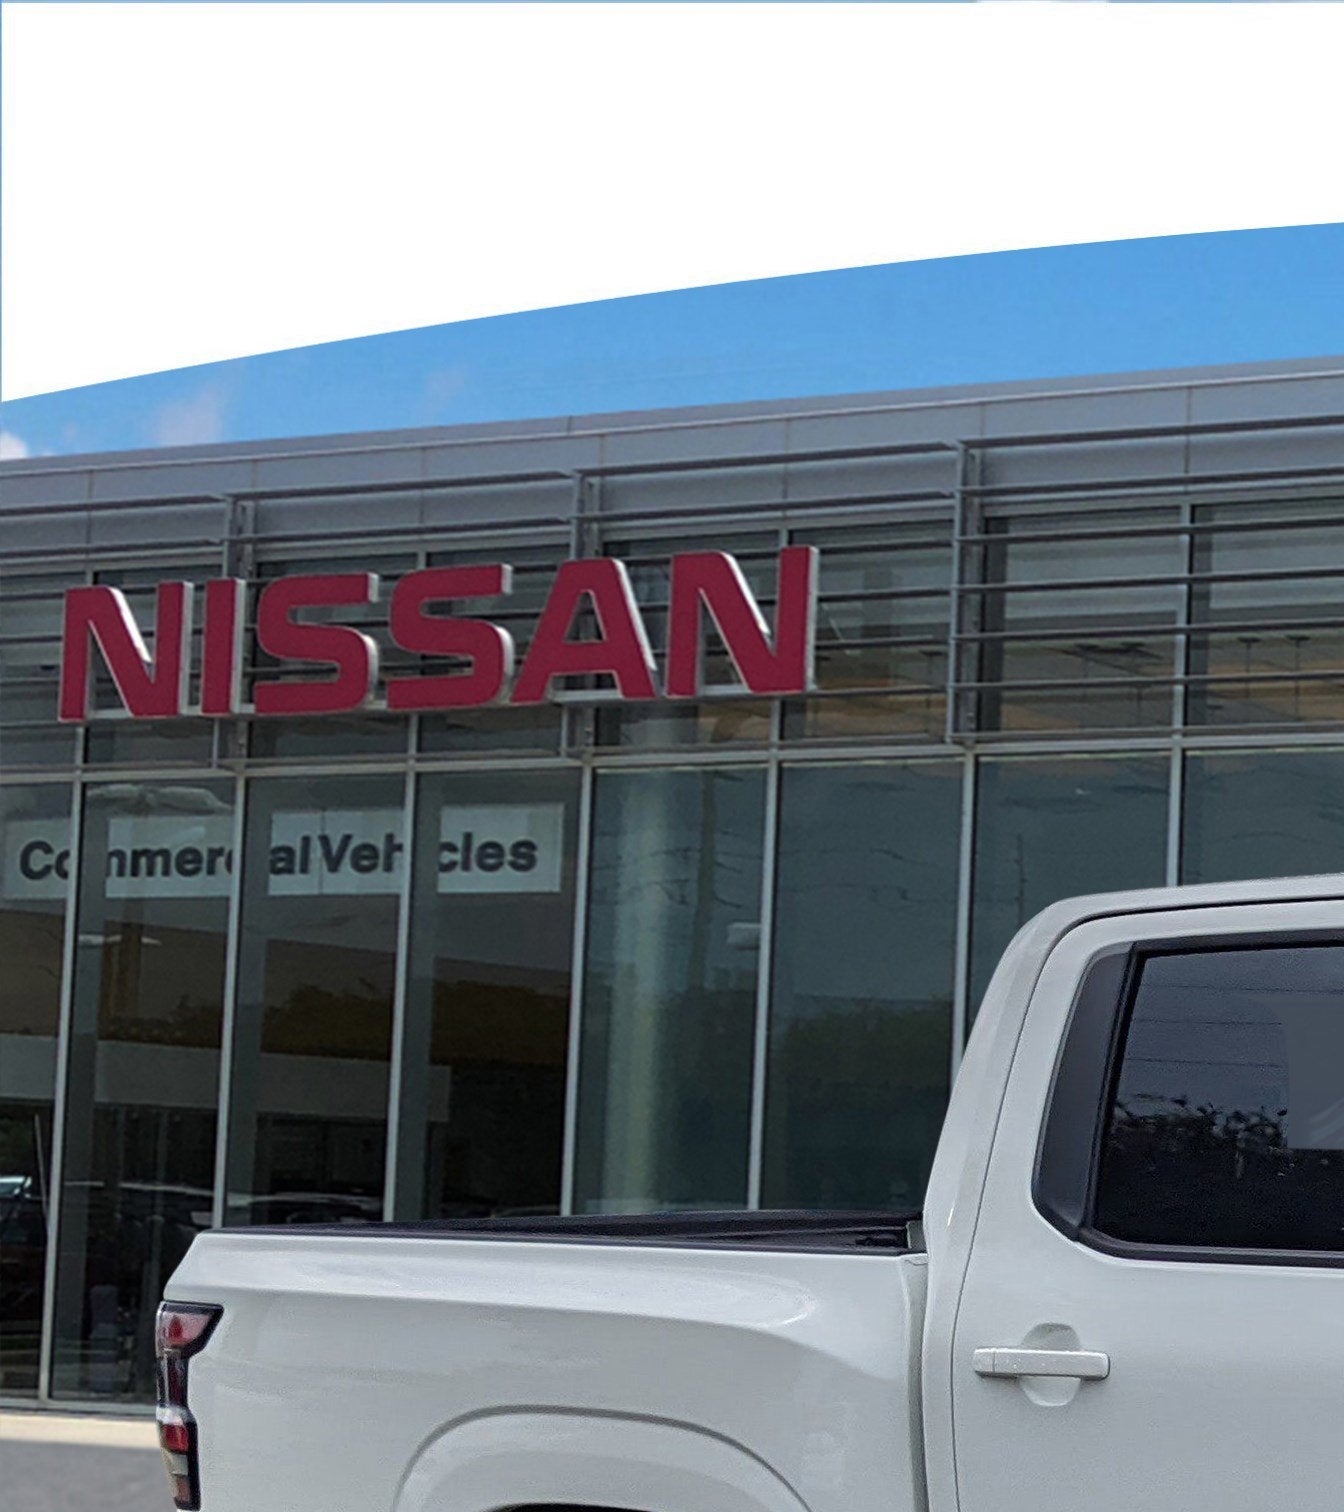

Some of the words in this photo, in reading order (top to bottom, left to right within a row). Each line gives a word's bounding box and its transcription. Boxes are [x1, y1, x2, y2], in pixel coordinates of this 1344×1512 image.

[58, 546, 819, 722] NISSAN
[19, 834, 311, 881] Cmeral
[318, 831, 538, 874] Vehcles
